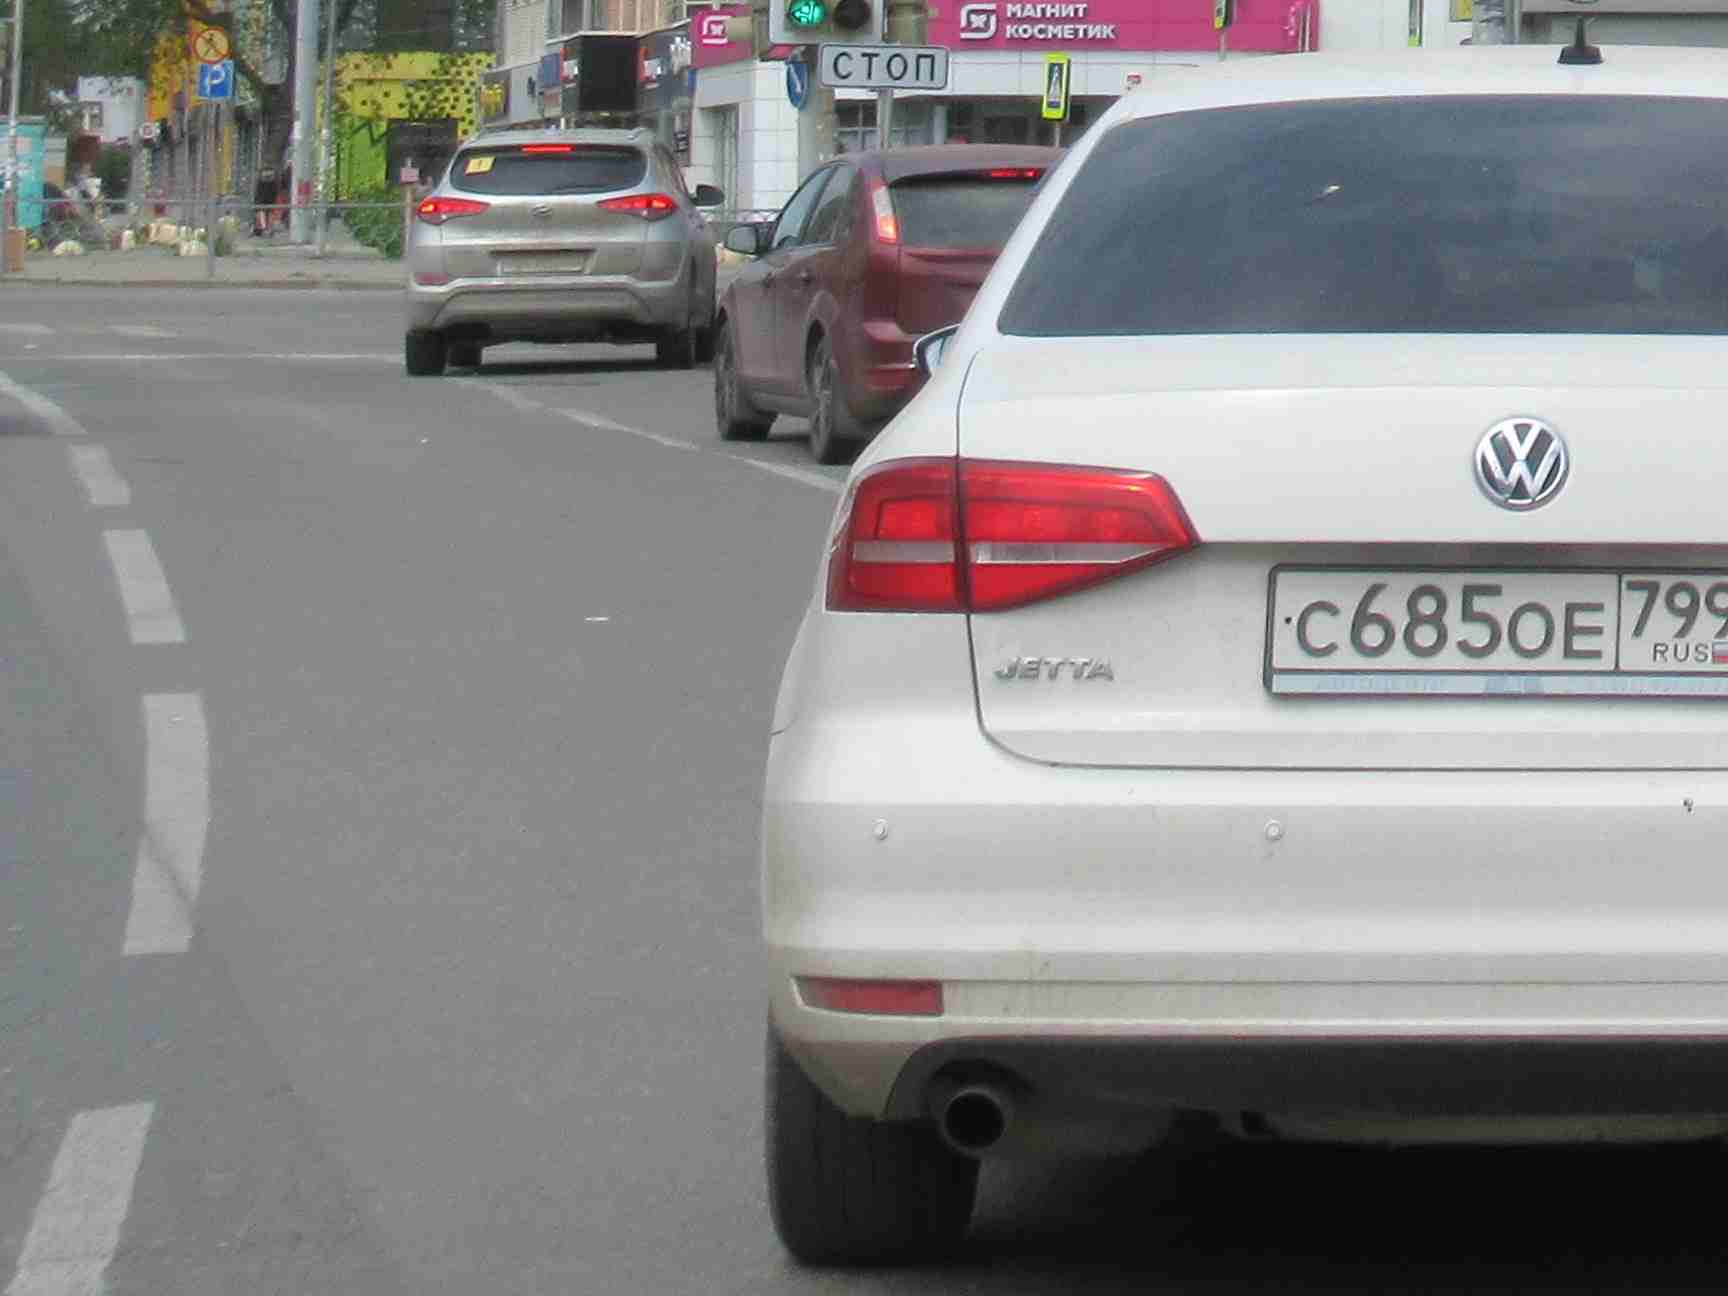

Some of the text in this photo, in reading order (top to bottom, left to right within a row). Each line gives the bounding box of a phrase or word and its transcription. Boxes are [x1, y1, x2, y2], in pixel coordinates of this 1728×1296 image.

[1006, 3, 1088, 18] МАГНИТ
[1005, 24, 1116, 40] КОСМЕТИК
[831, 53, 940, 84] СТОП
[1653, 642, 1709, 663] RUS
[994, 657, 1114, 682] JETTA
